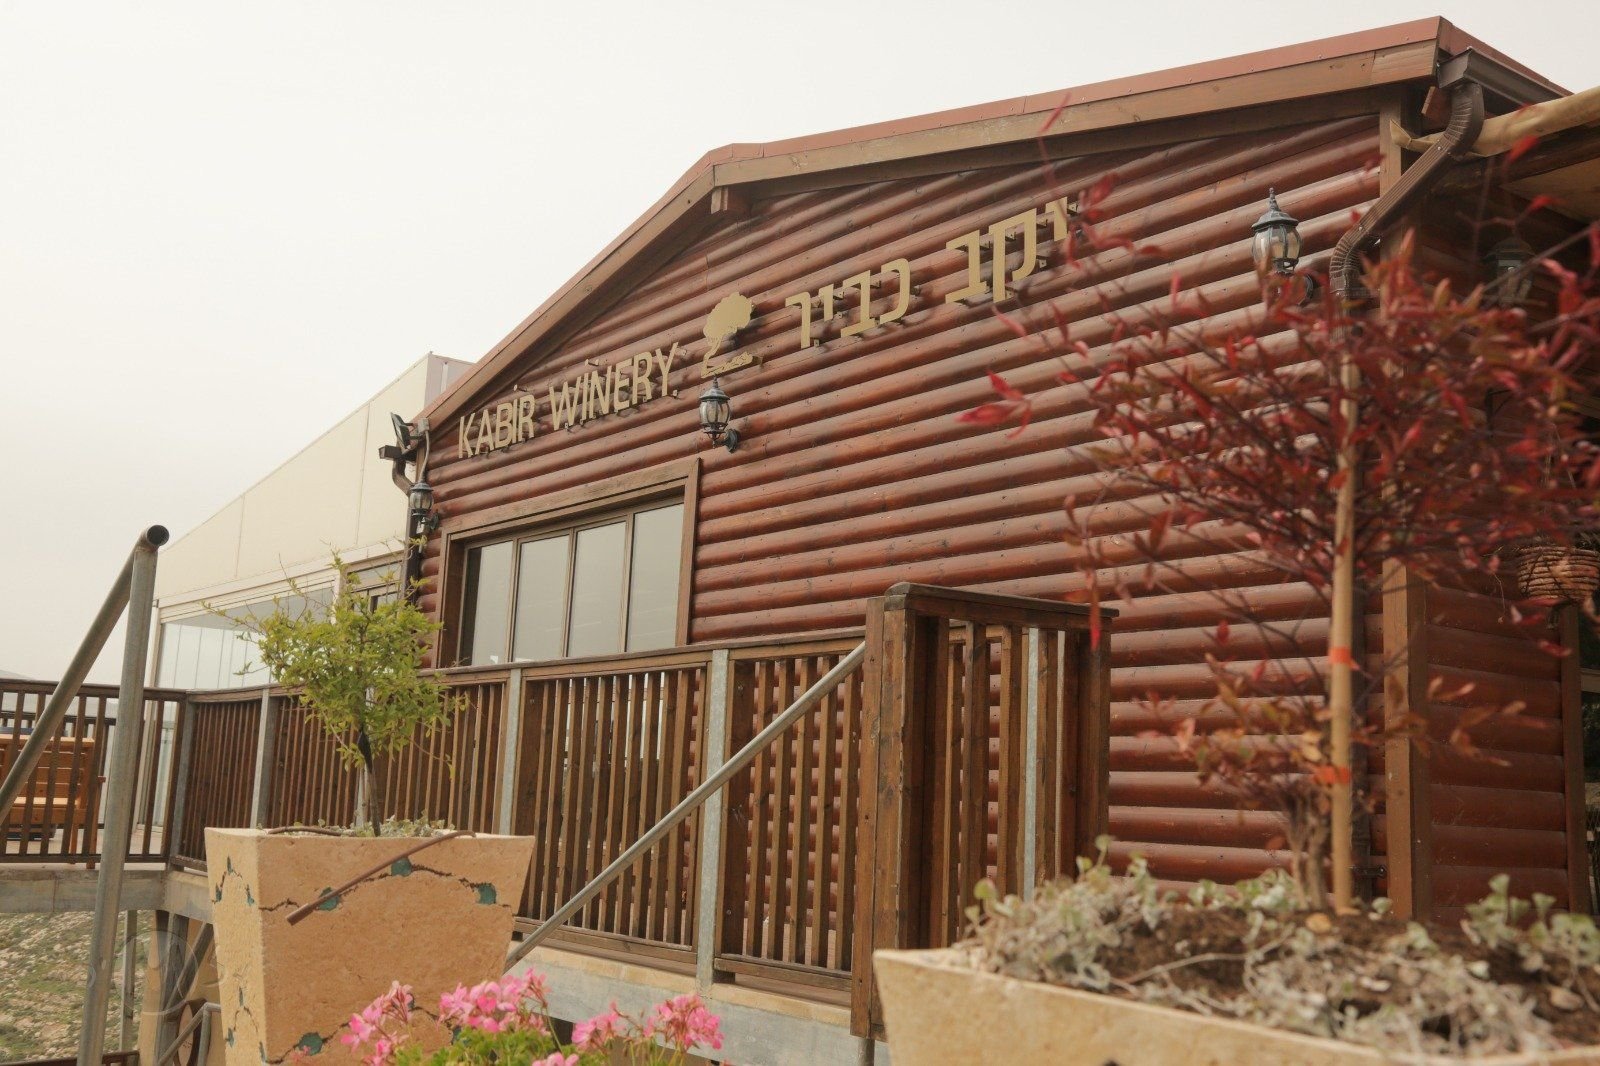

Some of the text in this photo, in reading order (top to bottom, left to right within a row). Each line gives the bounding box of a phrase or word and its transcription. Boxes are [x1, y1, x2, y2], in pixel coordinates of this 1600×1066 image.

[785, 196, 1068, 349] יקב כביר
[458, 341, 679, 459] KABIR WINERY
